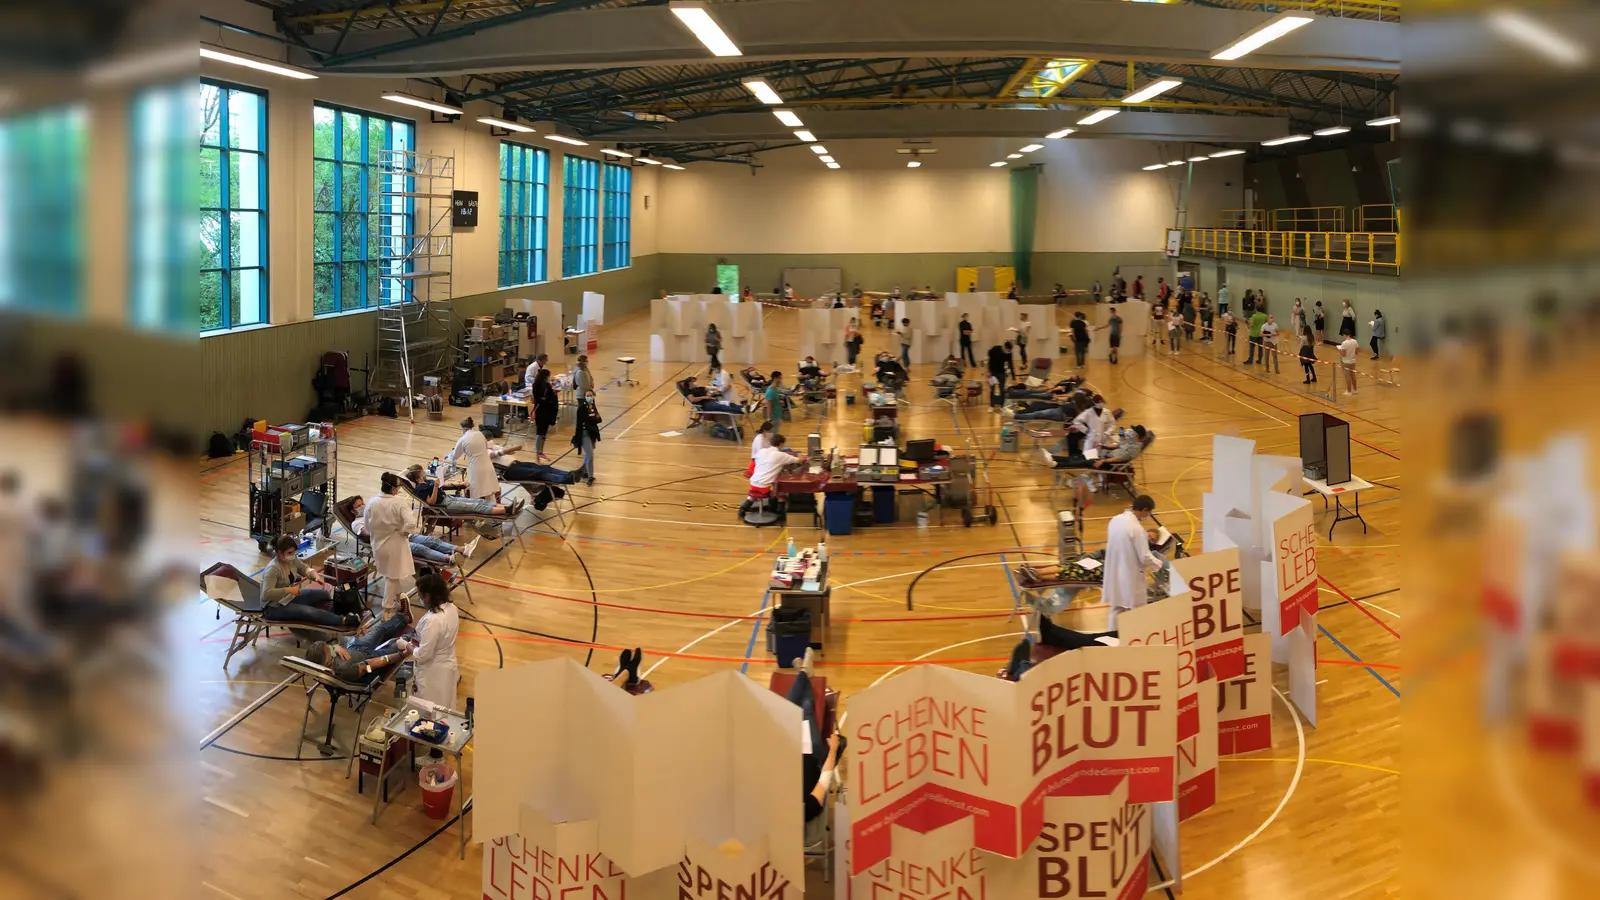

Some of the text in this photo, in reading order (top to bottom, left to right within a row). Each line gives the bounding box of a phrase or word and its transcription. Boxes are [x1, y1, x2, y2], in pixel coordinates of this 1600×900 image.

[856, 696, 988, 755] SCHENKE
[1030, 671, 1161, 726] SPENDE
[859, 730, 988, 805] LEBEN
[1032, 704, 1161, 777] BLUT
[845, 839, 986, 896] HENKE
